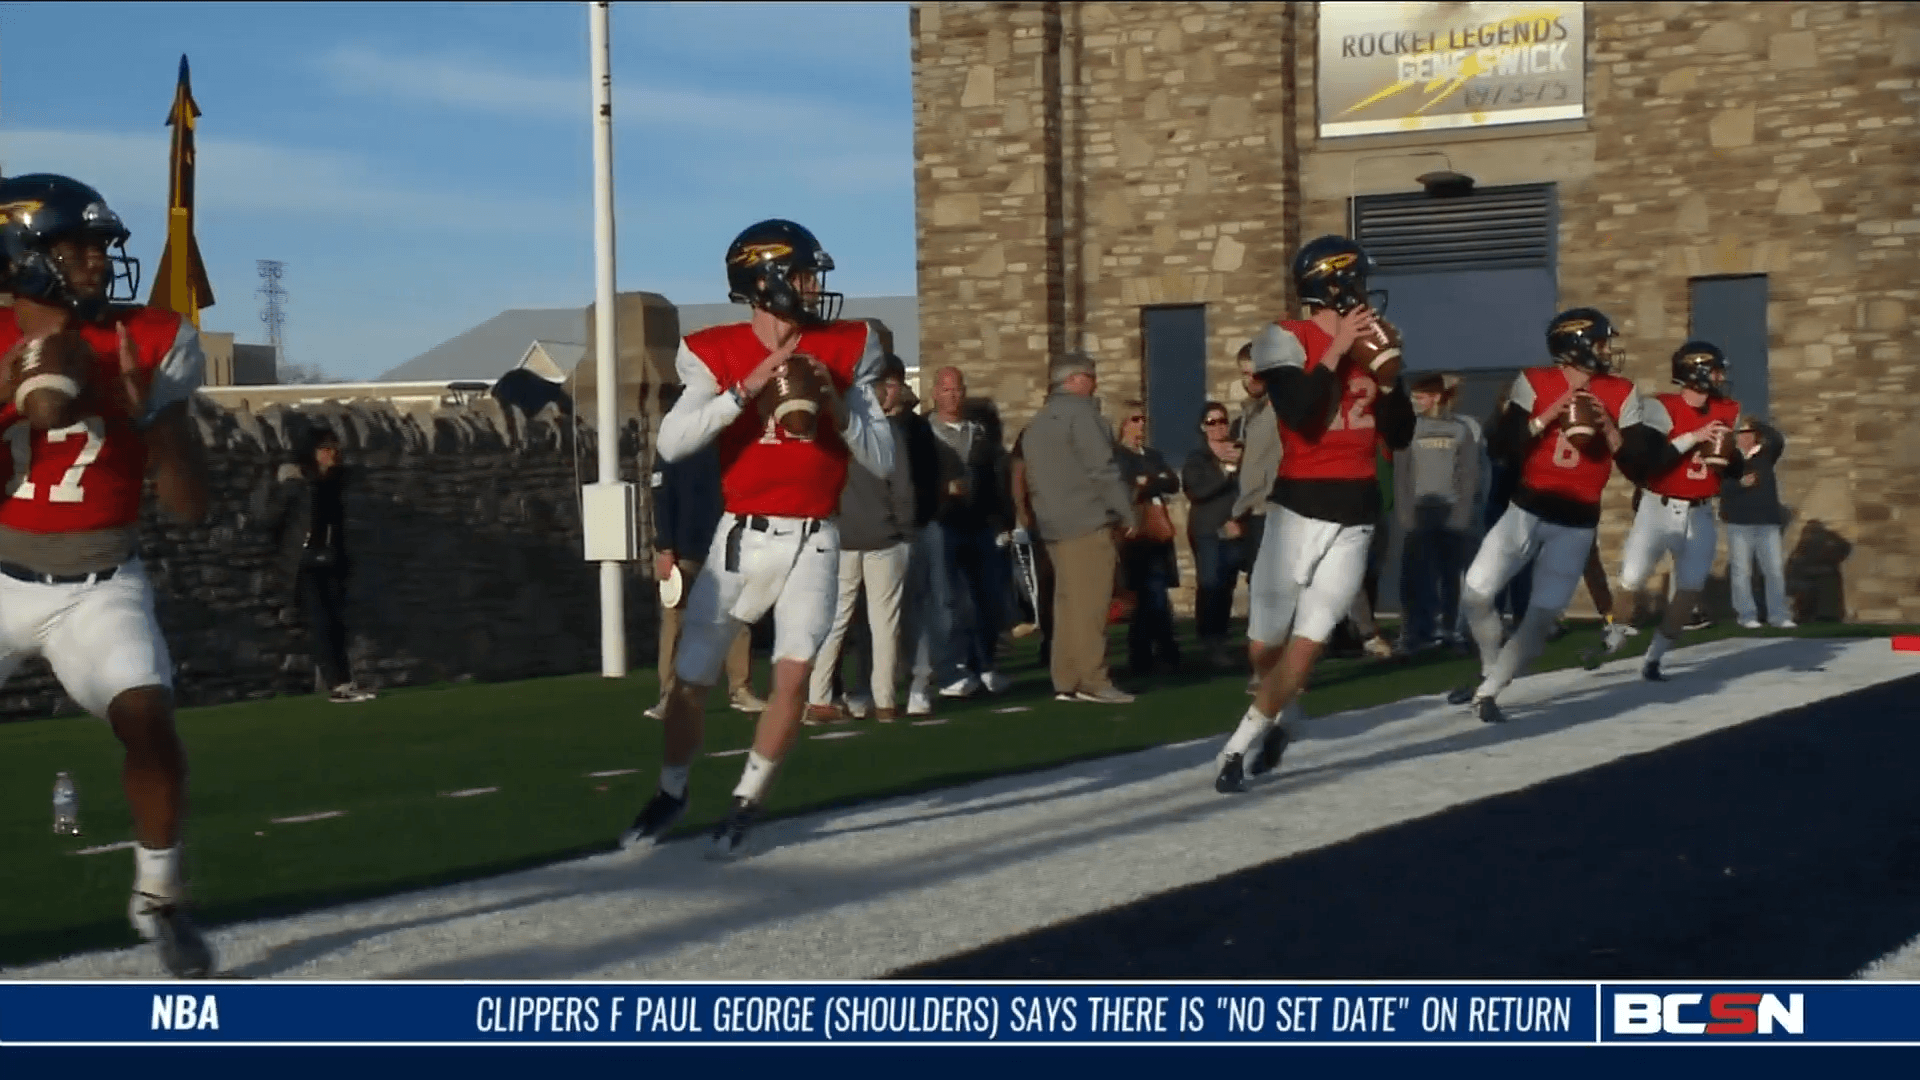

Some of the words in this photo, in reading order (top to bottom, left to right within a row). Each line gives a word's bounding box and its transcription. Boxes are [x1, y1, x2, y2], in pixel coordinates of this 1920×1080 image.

[1342, 30, 1436, 58] ROCKET
[1448, 17, 1568, 49] LEGENDS
[1397, 50, 1467, 83] GENE
[1477, 41, 1569, 78] SWICK
[2, 414, 106, 503] 17
